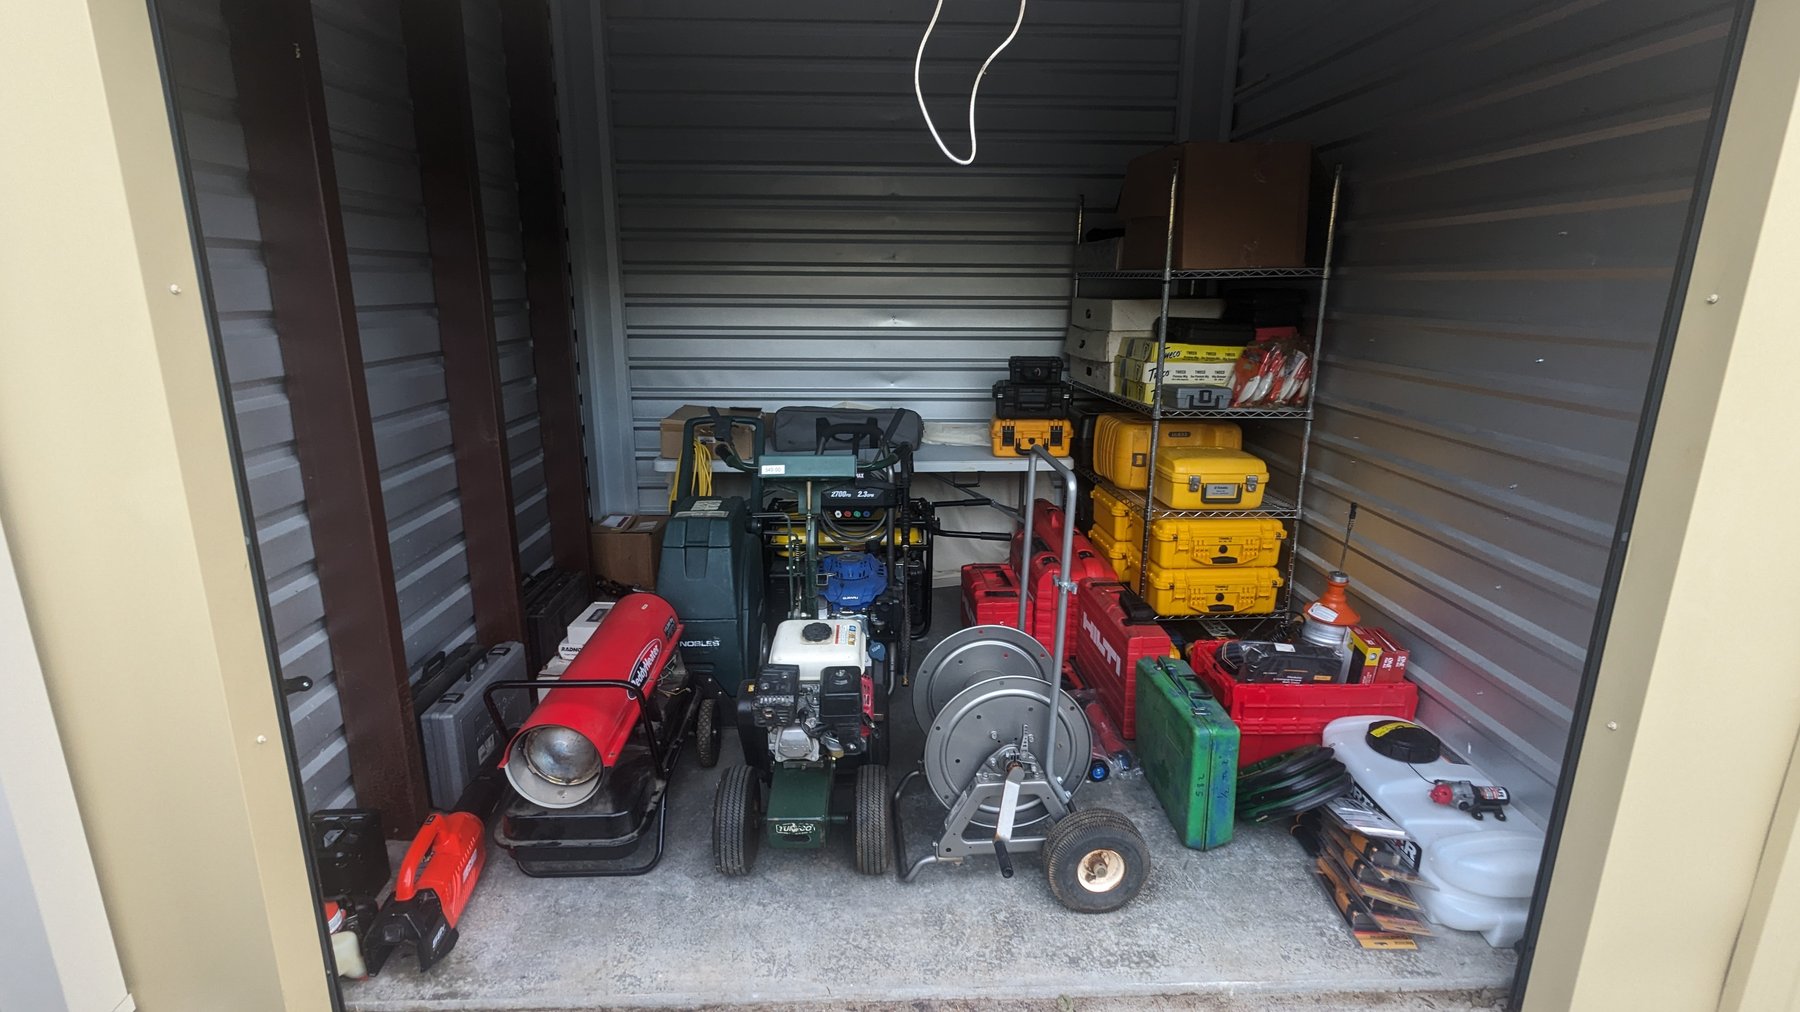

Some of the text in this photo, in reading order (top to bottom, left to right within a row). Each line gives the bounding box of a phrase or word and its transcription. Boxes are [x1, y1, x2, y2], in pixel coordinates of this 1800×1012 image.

[1164, 347, 1181, 359] weco
[1148, 367, 1170, 382] Tco
[1083, 611, 1121, 677] HILTI
